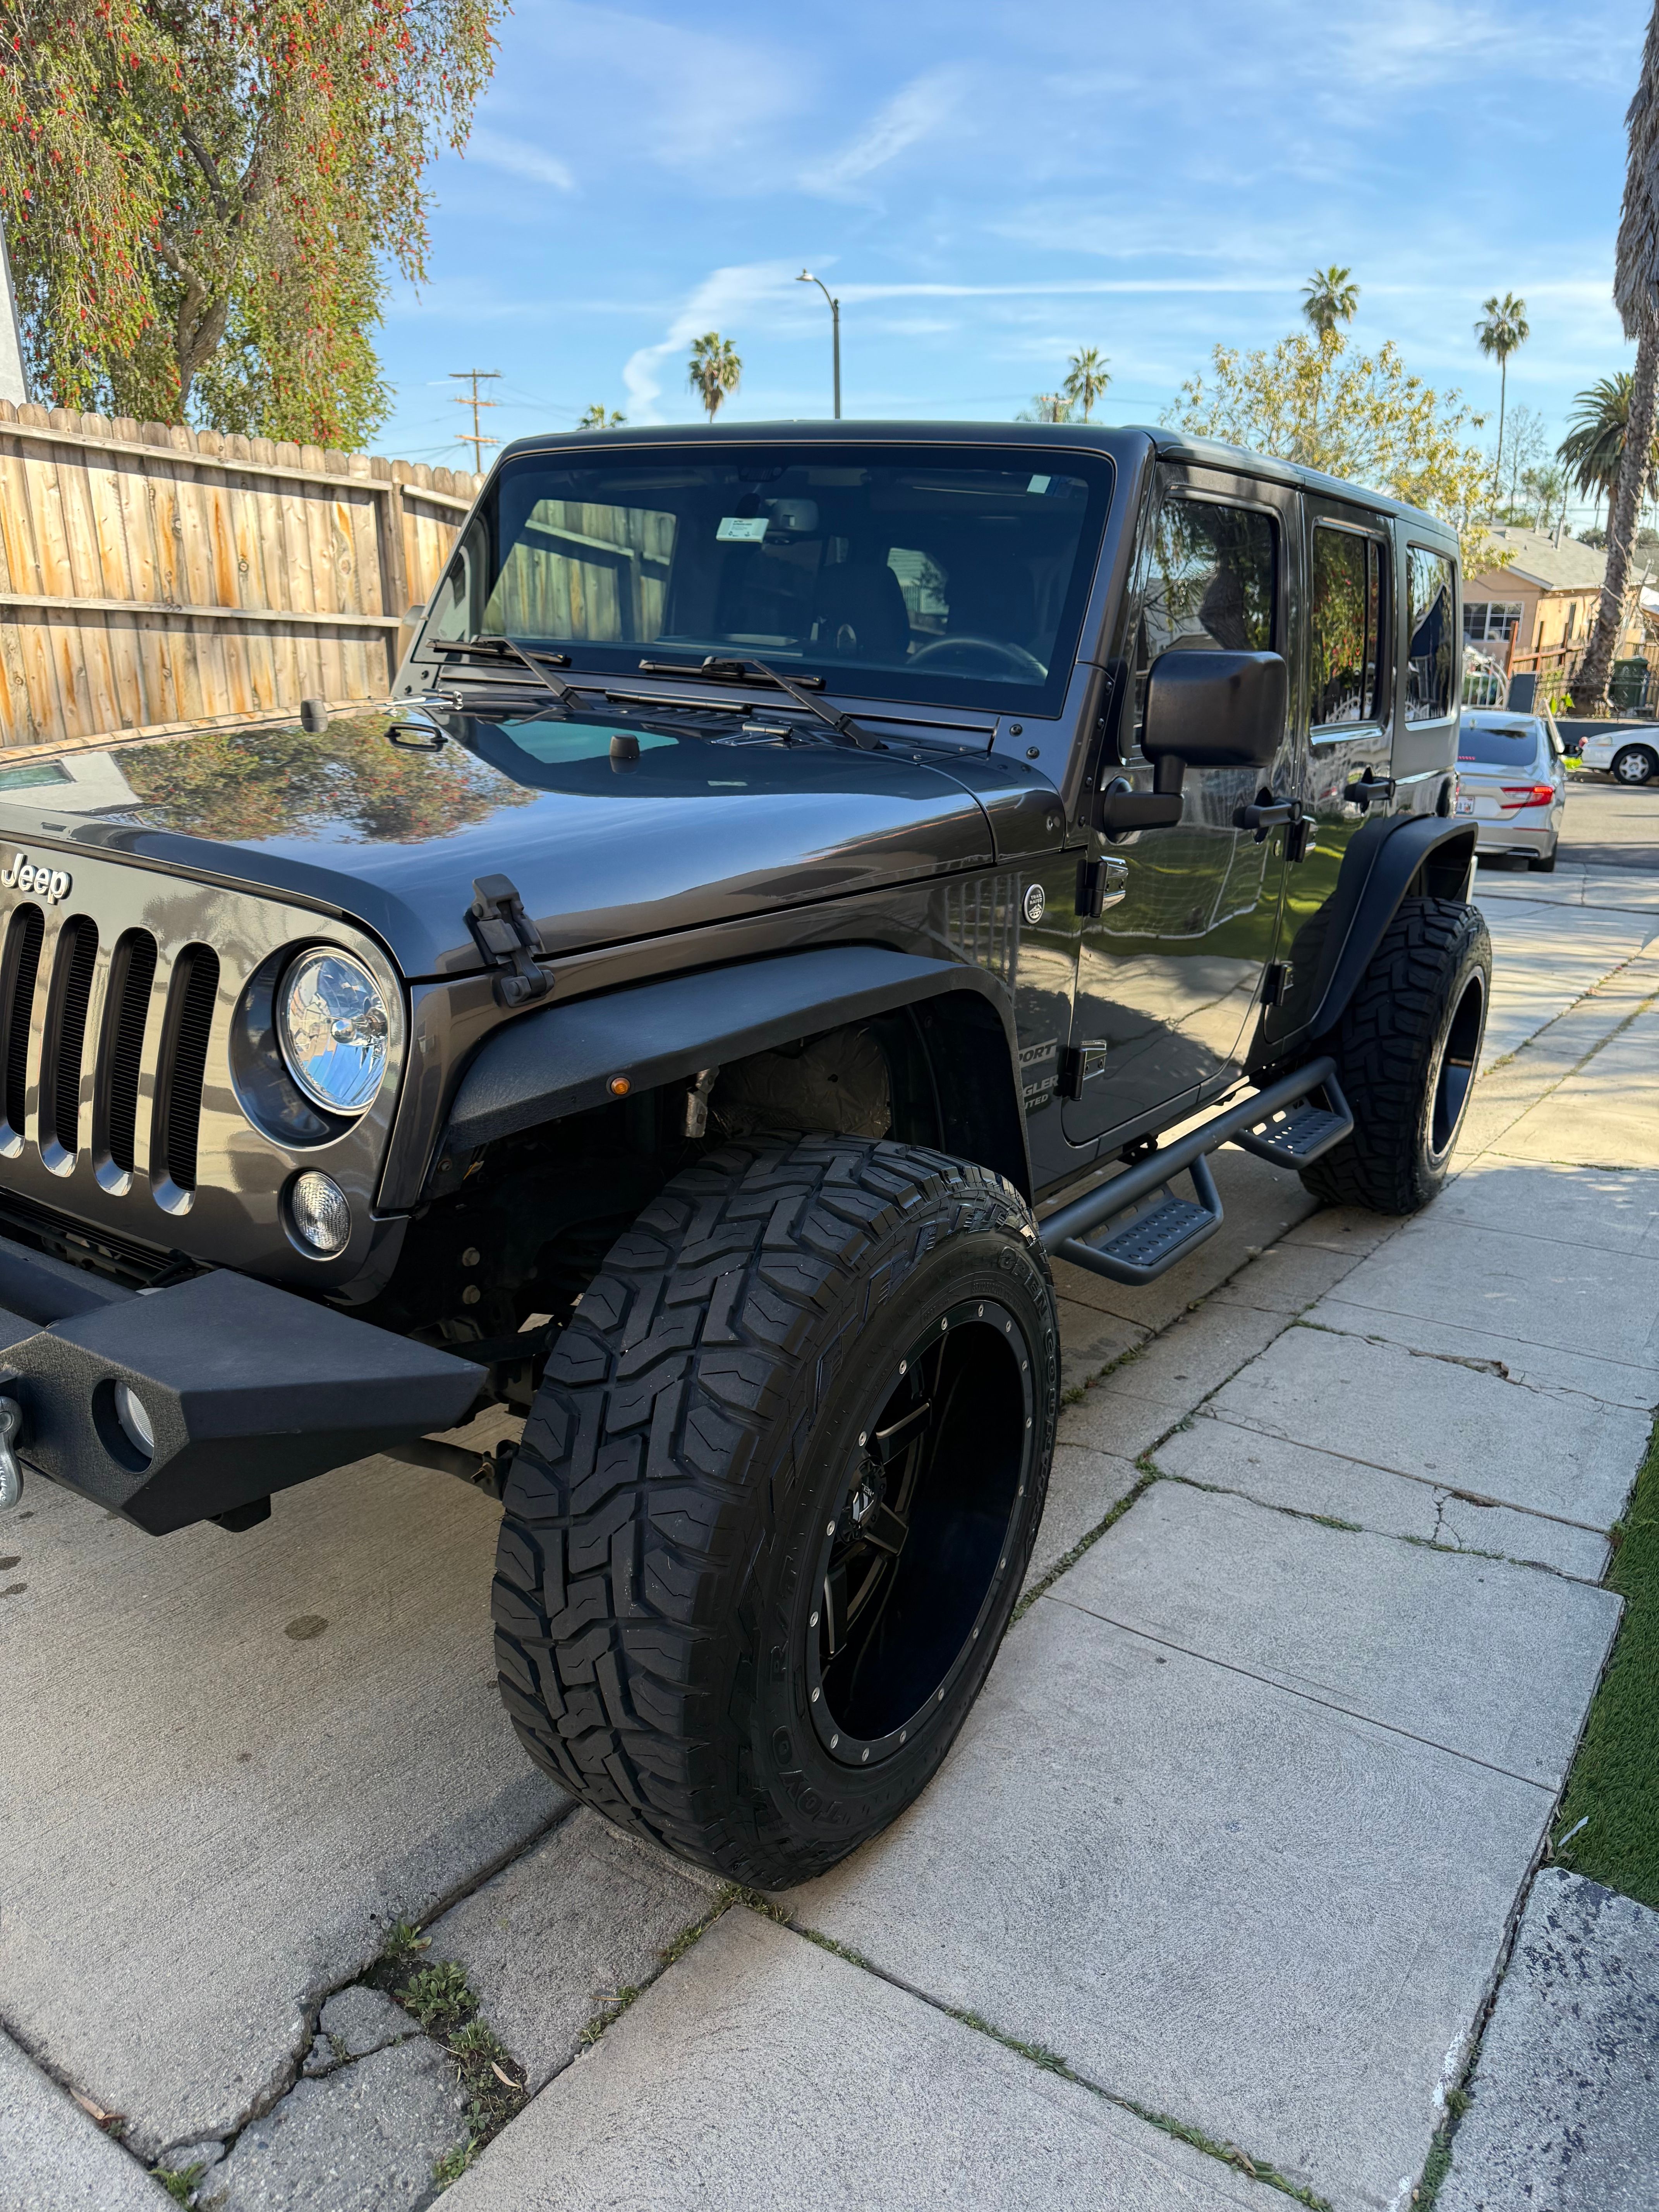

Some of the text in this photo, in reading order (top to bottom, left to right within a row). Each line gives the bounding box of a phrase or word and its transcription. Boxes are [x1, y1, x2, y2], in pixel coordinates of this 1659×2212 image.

[1, 853, 71, 905] Jeep
[1023, 1074, 1059, 1097] GLER
[1025, 1094, 1048, 1109] ITED
[998, 1246, 1048, 1321] OPEN
[772, 1725, 843, 1824] TOYO
